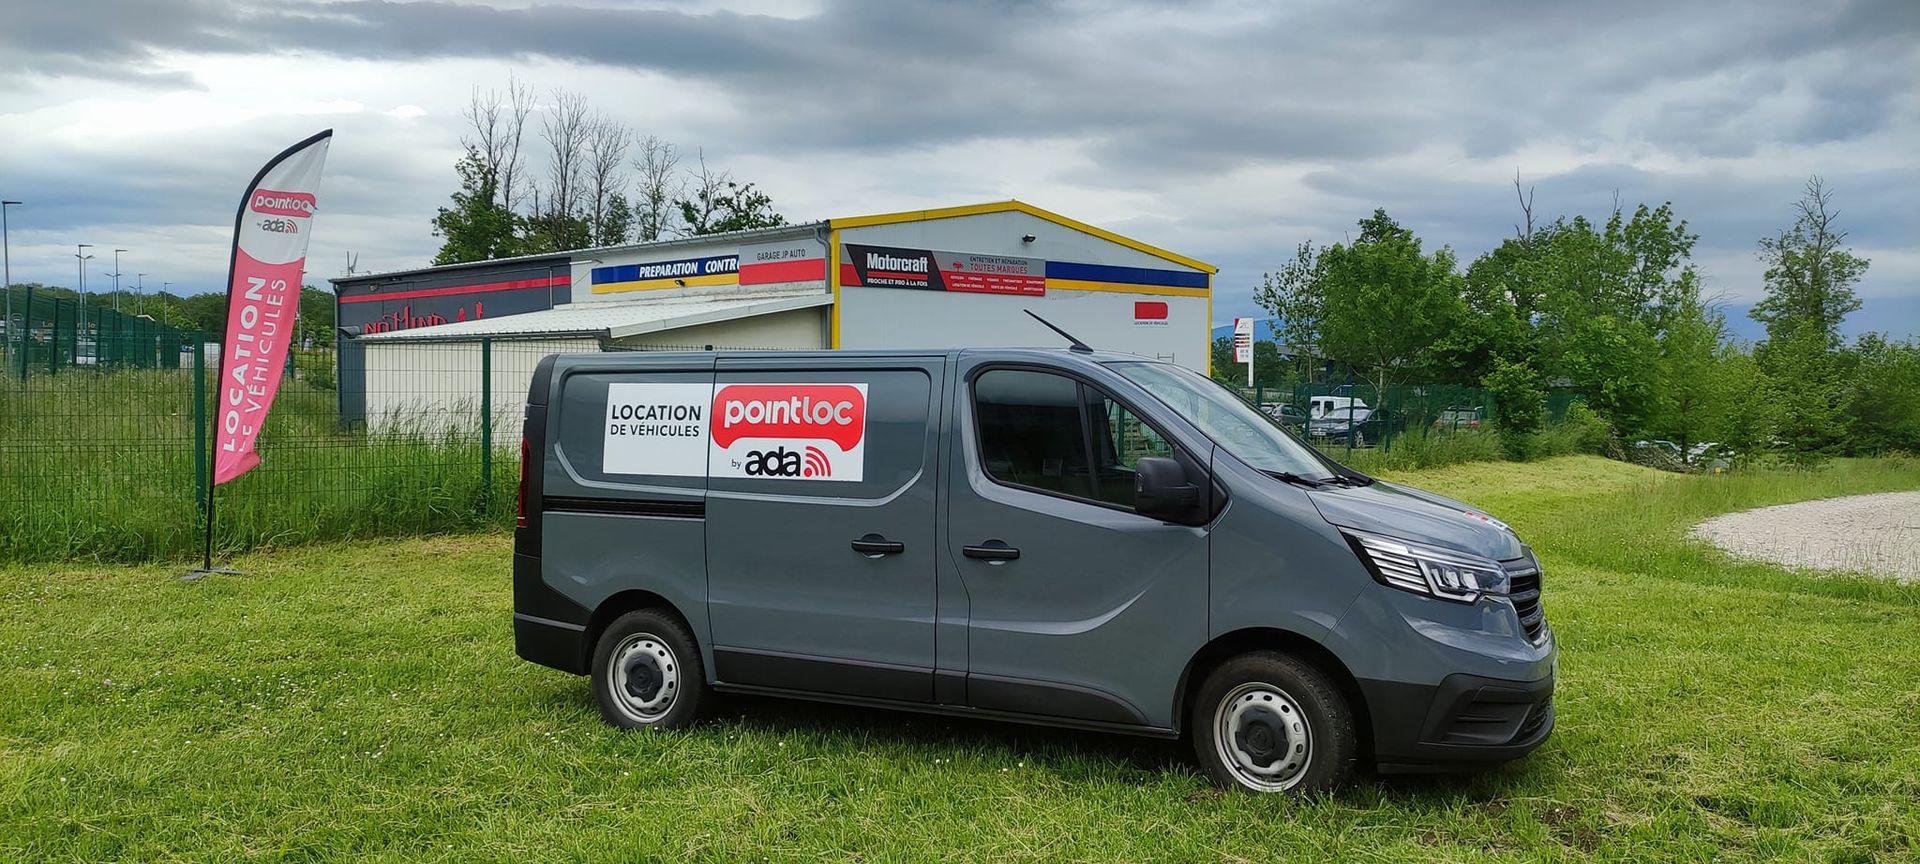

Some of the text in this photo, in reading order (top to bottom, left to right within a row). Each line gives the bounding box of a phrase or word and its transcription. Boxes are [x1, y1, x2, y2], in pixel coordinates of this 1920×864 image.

[262, 219, 286, 233] ada
[757, 248, 806, 261] GARAGE JP AUTO
[867, 252, 928, 272] Motorcraft
[639, 258, 740, 278] PREPARATION CONTR
[970, 263, 1028, 274] TOUTES MARQUES
[867, 277, 887, 285] PROCHE
[244, 279, 287, 413] VÉHICULES
[223, 276, 267, 452] LOCATION
[611, 404, 702, 421] LOCATION
[724, 395, 854, 428] pointloc
[610, 421, 700, 437] DE VÉHICULES
[731, 446, 801, 477] by ada
